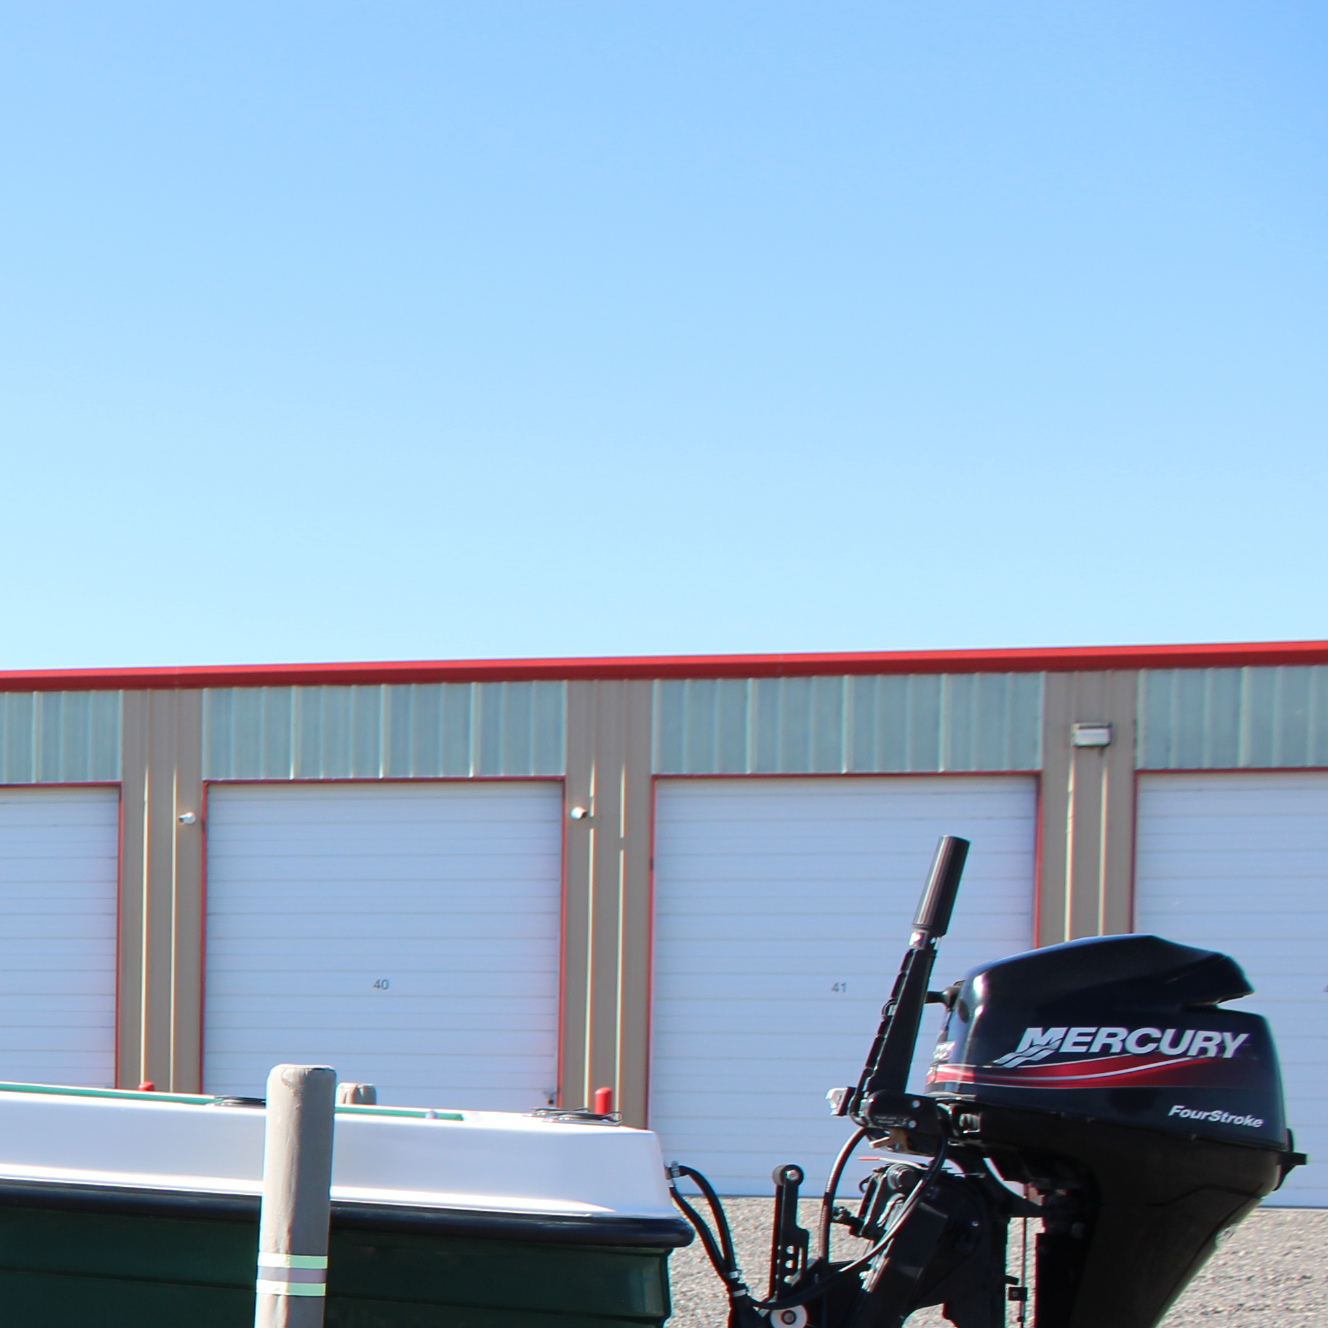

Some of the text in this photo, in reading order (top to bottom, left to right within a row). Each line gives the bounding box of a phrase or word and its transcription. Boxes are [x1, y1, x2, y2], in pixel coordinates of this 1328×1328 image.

[373, 979, 390, 991] 40
[830, 982, 847, 993] 41
[1012, 1026, 1250, 1060] MERCURY
[1168, 1105, 1265, 1129] FourStroke
